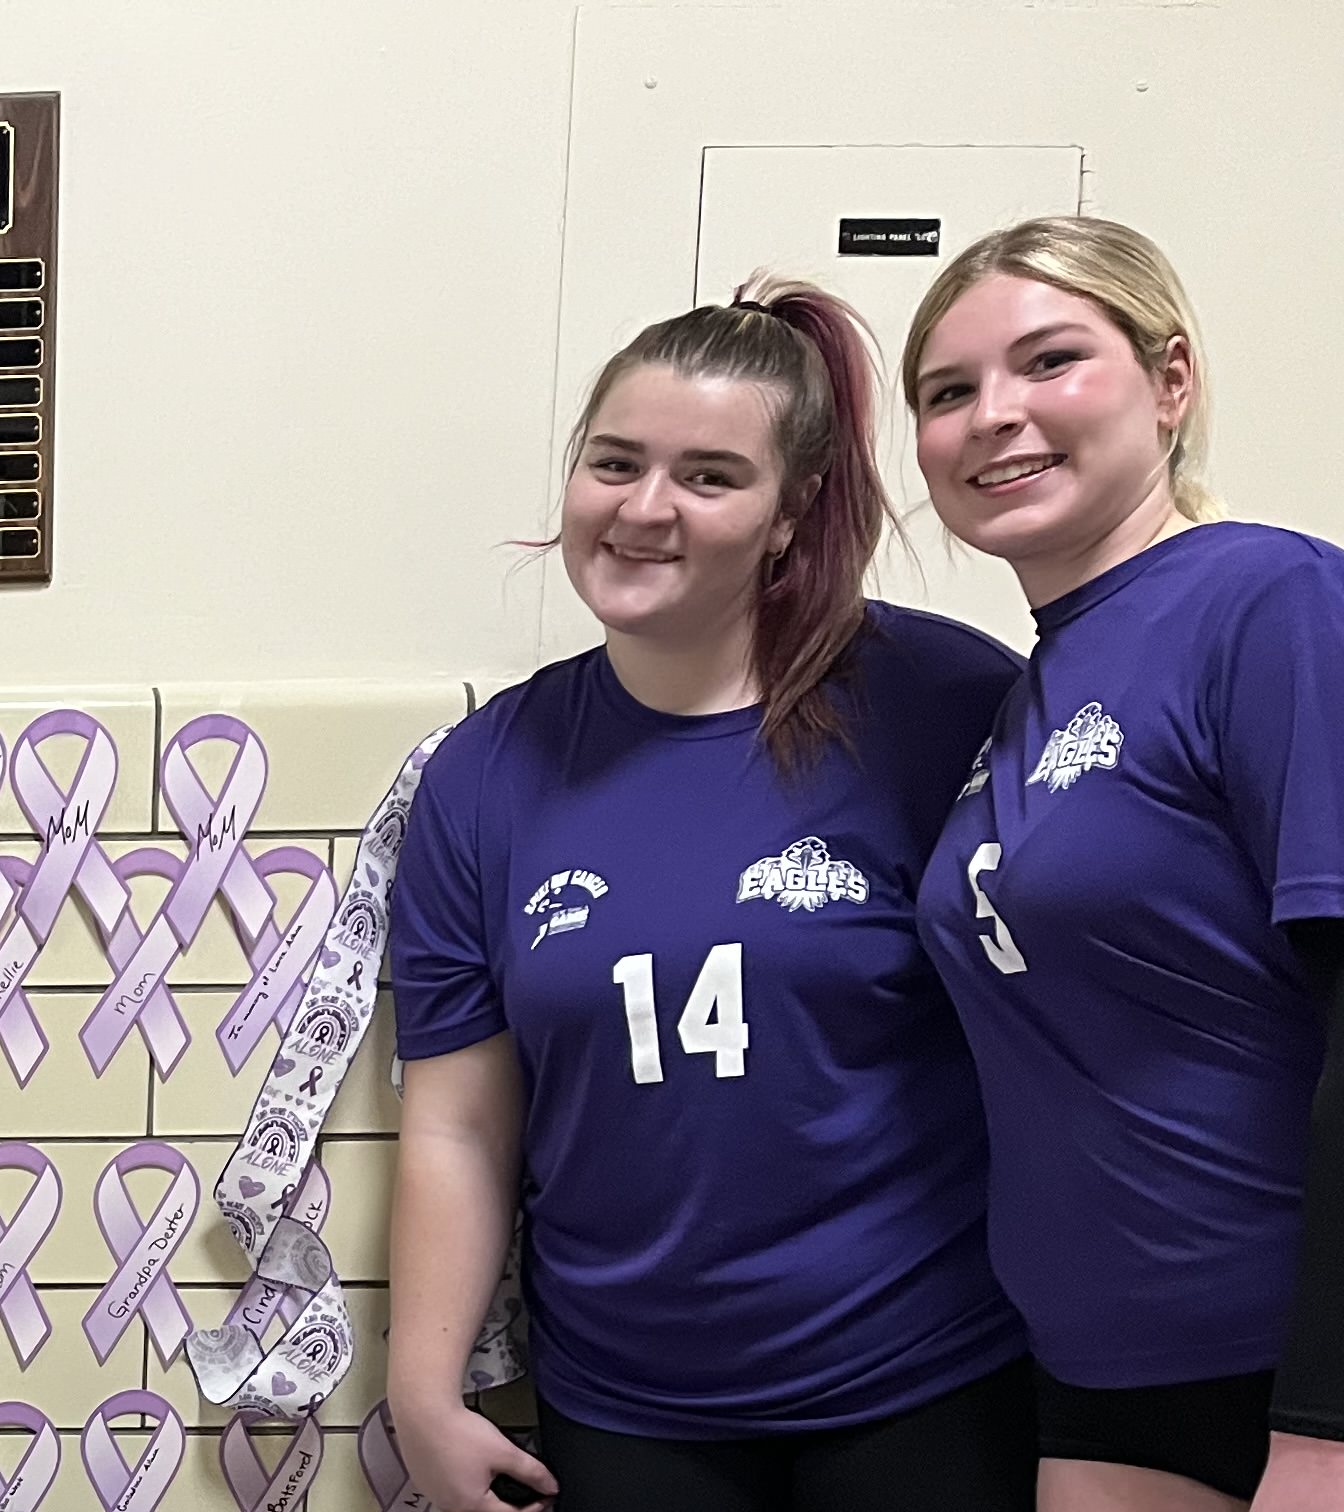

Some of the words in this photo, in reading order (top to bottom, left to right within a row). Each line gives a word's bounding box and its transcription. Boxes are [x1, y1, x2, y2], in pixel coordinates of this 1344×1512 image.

[736, 862, 869, 904] EAGLES
[332, 930, 374, 961] ALONE
[612, 942, 749, 1084] 14
[288, 1037, 343, 1066] ALONE
[239, 1148, 296, 1177] ALONE
[107, 1258, 160, 1320] Grandpa
[148, 1203, 185, 1252] Dexter
[243, 1284, 278, 1325] Cind
[278, 1349, 330, 1384] ALONE
